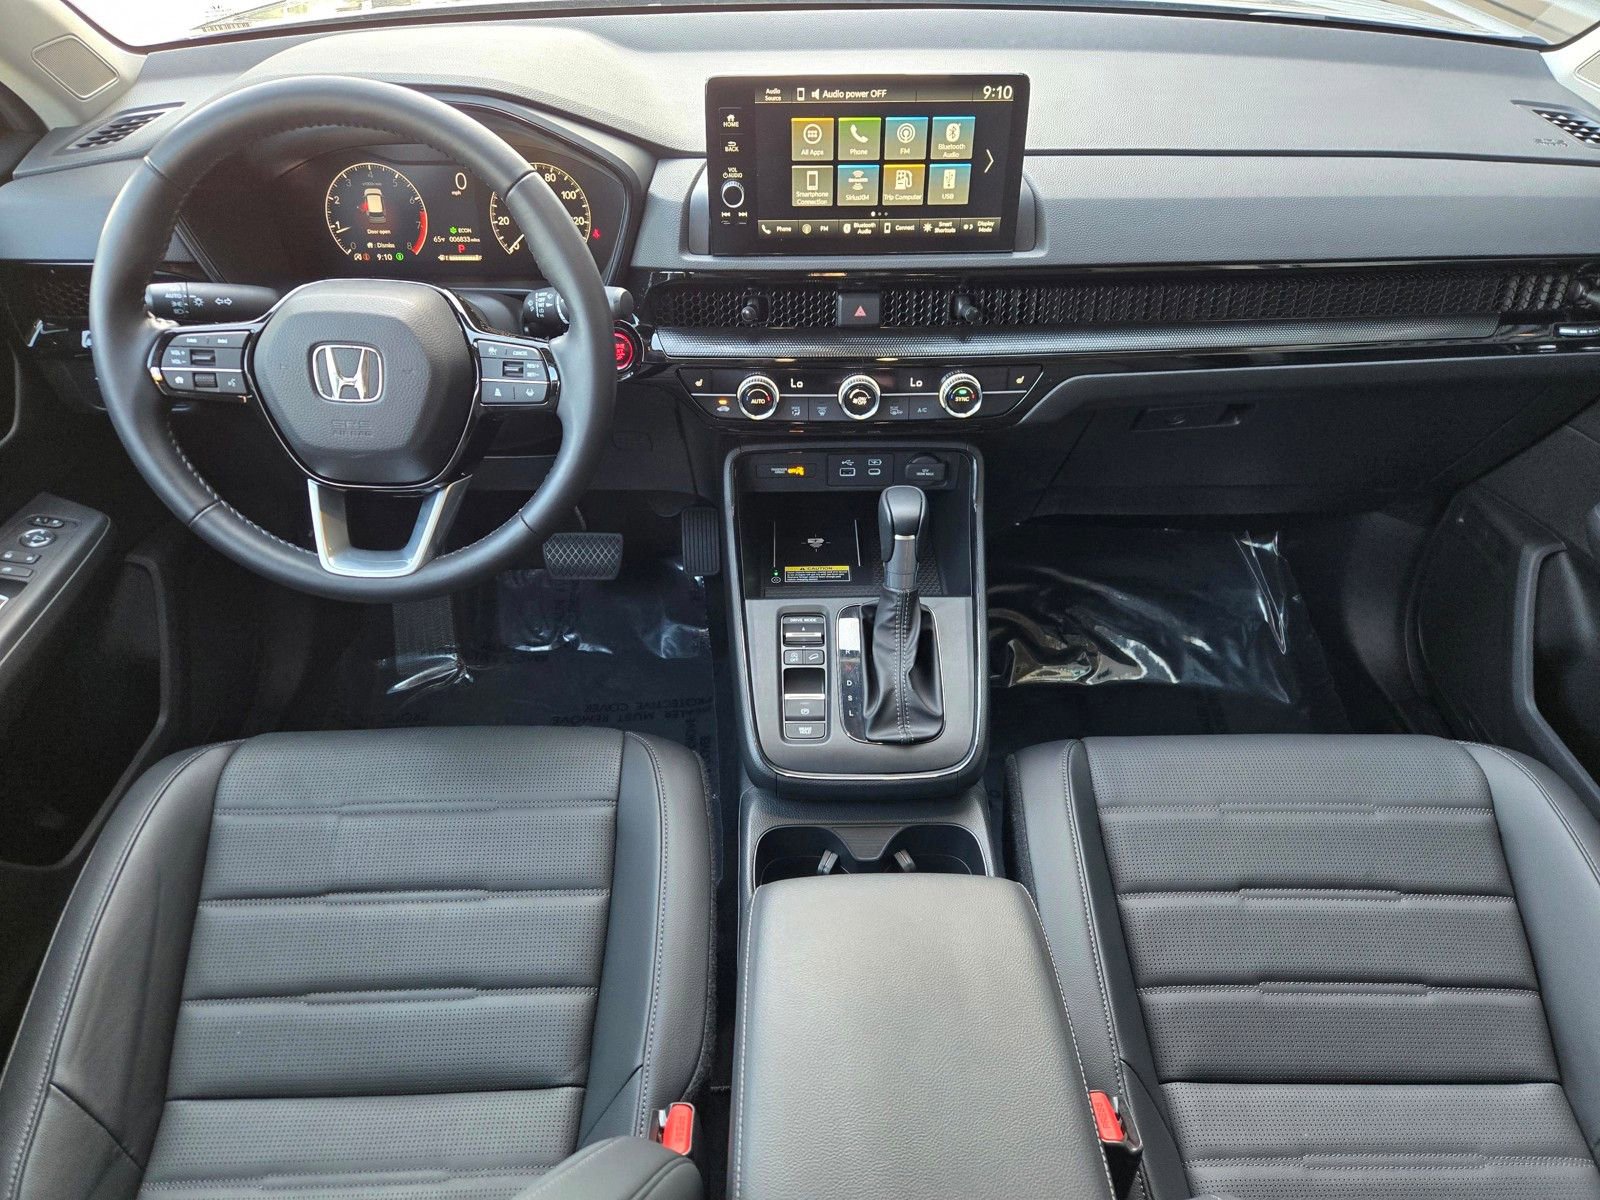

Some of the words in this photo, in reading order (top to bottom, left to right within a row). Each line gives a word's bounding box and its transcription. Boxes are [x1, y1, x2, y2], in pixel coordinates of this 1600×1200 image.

[822, 90, 844, 98] Audio
[846, 91, 868, 100] power
[983, 86, 1012, 100] 9:10
[455, 172, 467, 190] 0
[545, 174, 556, 182] 80
[561, 191, 577, 199] 100
[334, 196, 340, 204] 2
[498, 217, 509, 225] 20
[571, 217, 584, 225] 20
[458, 245, 466, 253] P
[790, 378, 803, 388] Lo
[910, 377, 923, 388] Lo
